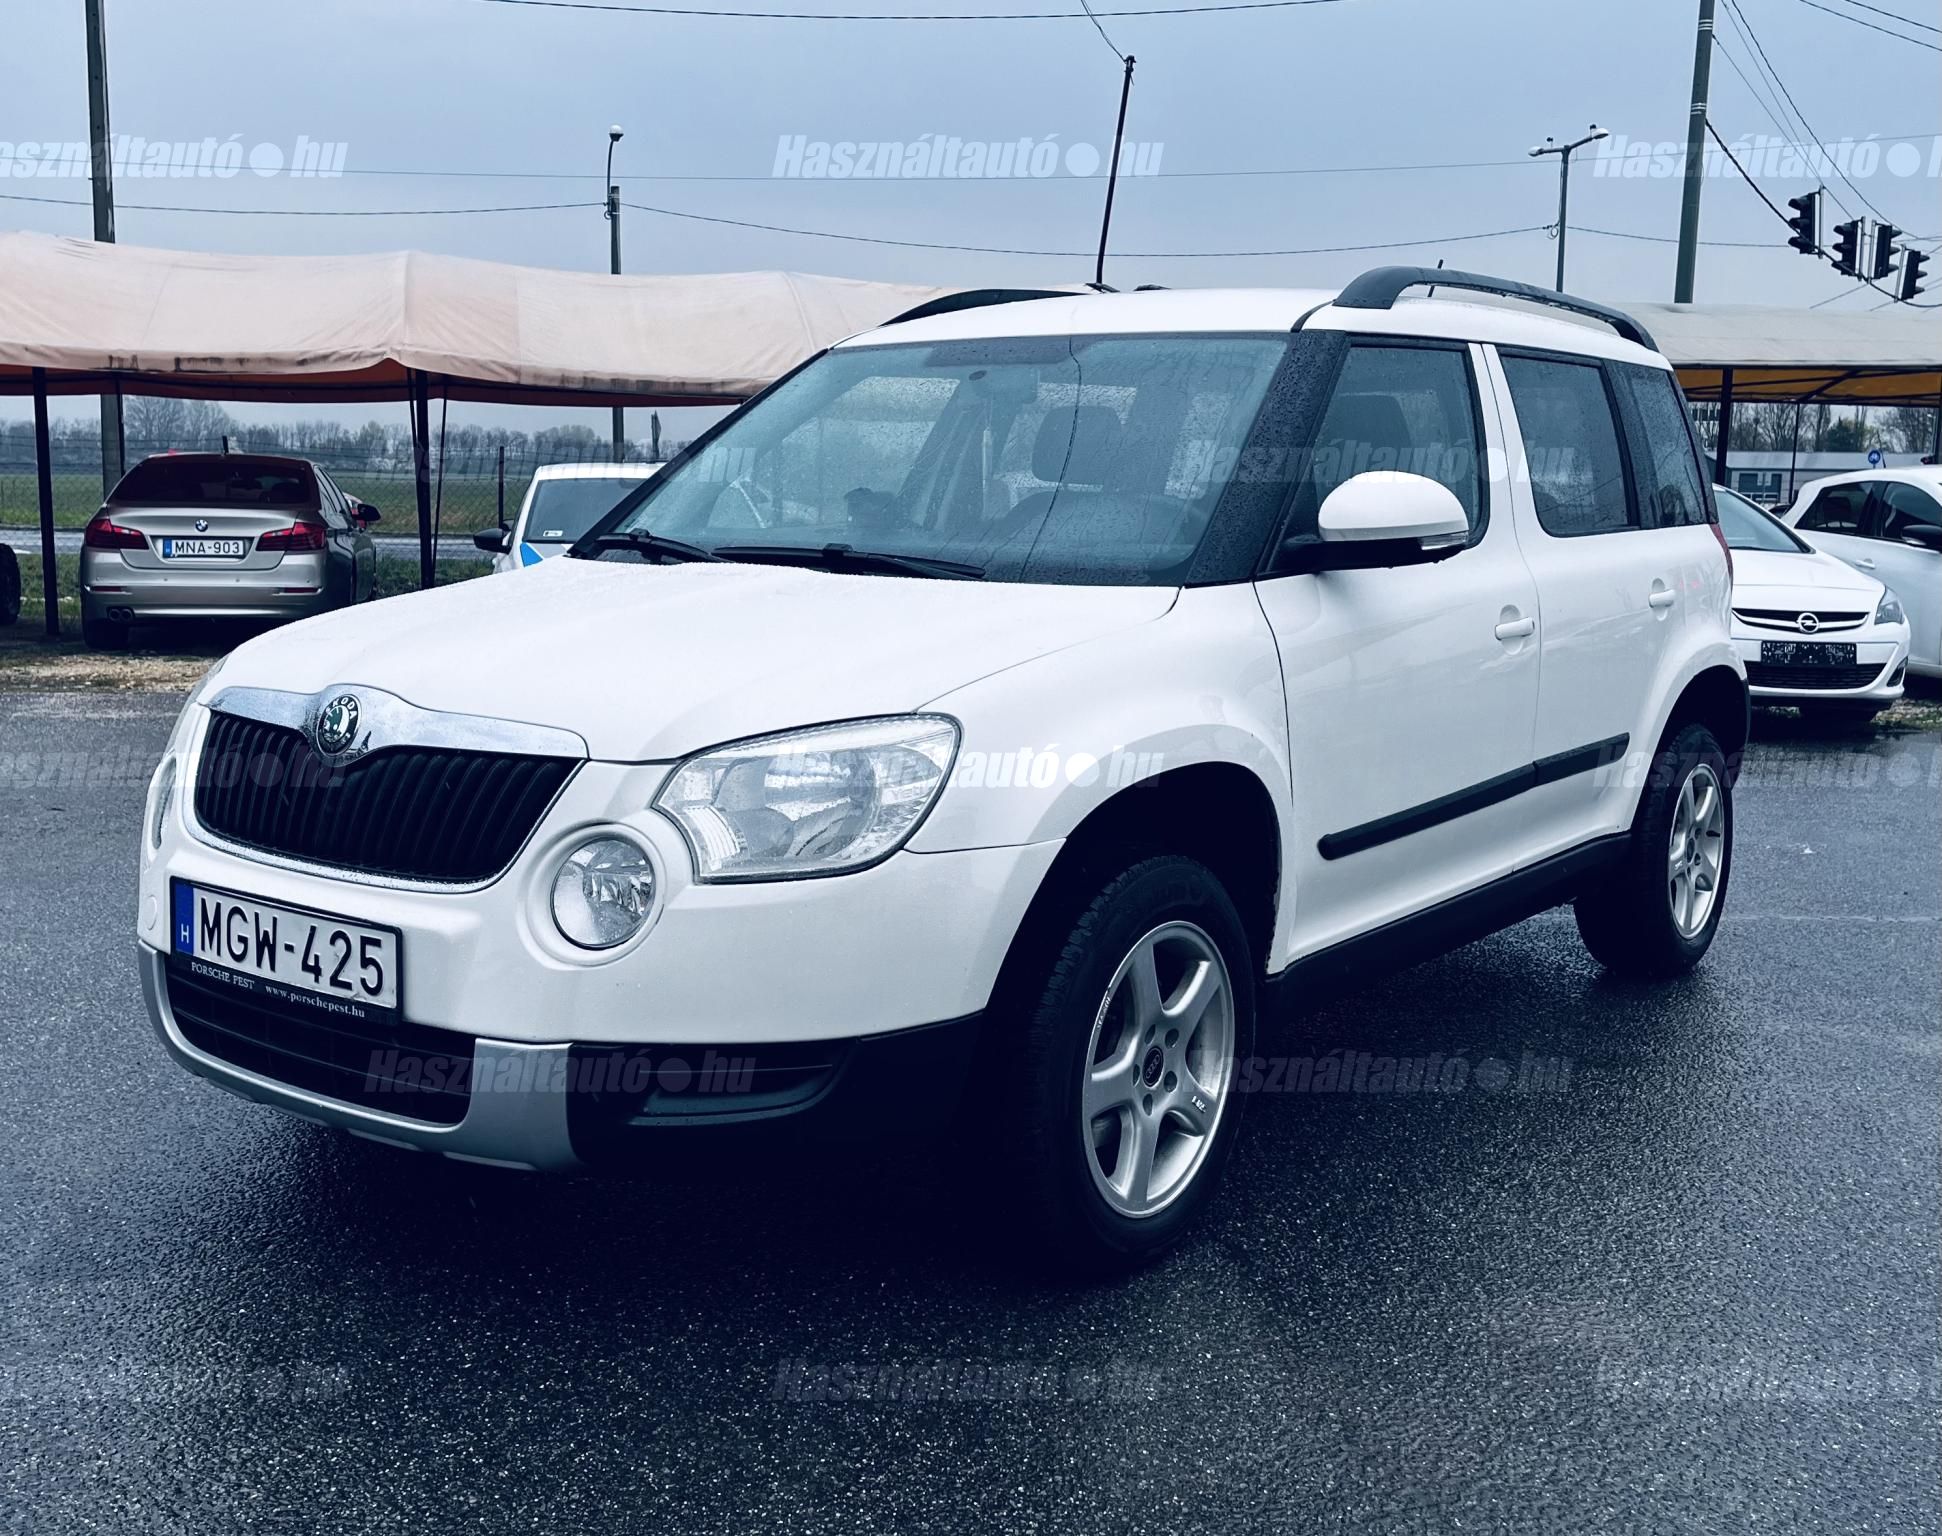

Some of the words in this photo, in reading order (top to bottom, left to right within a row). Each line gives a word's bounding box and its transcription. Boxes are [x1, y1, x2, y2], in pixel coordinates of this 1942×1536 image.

[175, 541, 240, 554] MNA-903
[180, 923, 190, 944] H
[200, 896, 384, 997] MGW-425
[191, 961, 231, 983] PORSCHE
[233, 975, 255, 990] PEST
[265, 985, 365, 1018] www.porschepest.hu
